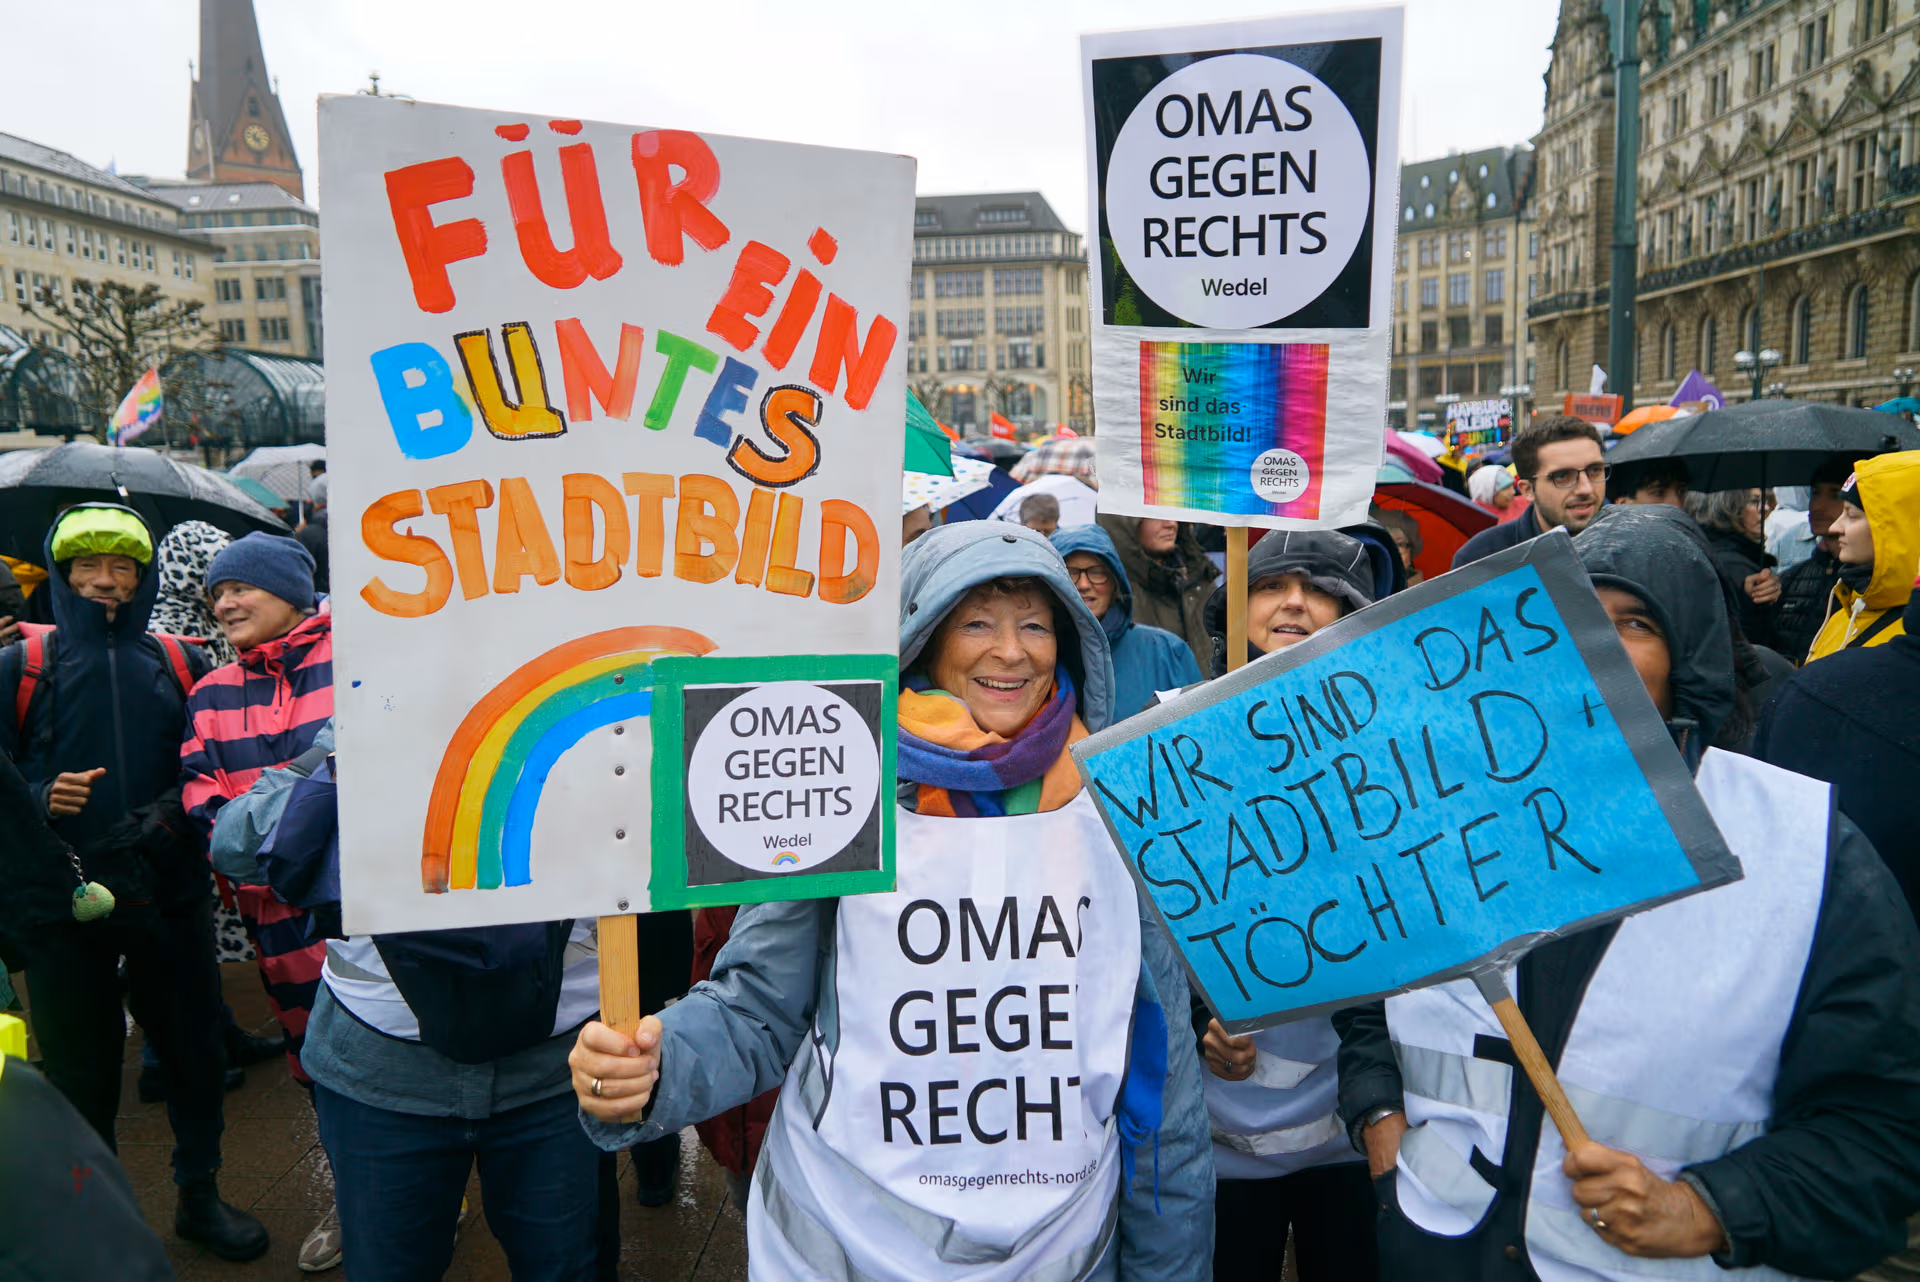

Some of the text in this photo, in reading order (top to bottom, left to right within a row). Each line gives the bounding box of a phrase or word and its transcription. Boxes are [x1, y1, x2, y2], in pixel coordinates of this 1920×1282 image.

[1155, 85, 1312, 138] OMAS
[1150, 149, 1317, 199] GEGEN
[383, 119, 730, 314] FÜR
[1143, 211, 1327, 258] RECHTS
[1201, 278, 1267, 296] Wedel
[706, 226, 898, 411] EIN
[1183, 368, 1216, 385] Wir
[370, 317, 822, 487] BUNTES
[1159, 395, 1241, 414] sind das
[1447, 399, 1510, 420] HAMBURG
[1155, 423, 1251, 443] Stadtbild!
[1456, 414, 1499, 433] BLEIBT
[1262, 468, 1297, 476] GEGEN
[1263, 457, 1296, 466] OMAS
[1260, 477, 1299, 487] RECHTS
[360, 472, 880, 618] STADTBILD
[730, 704, 841, 737] OMAS
[1094, 587, 1559, 829] WIR SIND DAS
[725, 745, 844, 780] GEGEN
[719, 786, 852, 823] RECHTS
[1136, 690, 1549, 921] STADTBILD
[763, 833, 812, 849] Wedel
[1187, 787, 1602, 1002] TÖCHTER
[889, 984, 1078, 1056] GEGE
[880, 1076, 1087, 1145] RECH
[919, 1159, 1097, 1191] omasgegenrechts-nord.de
